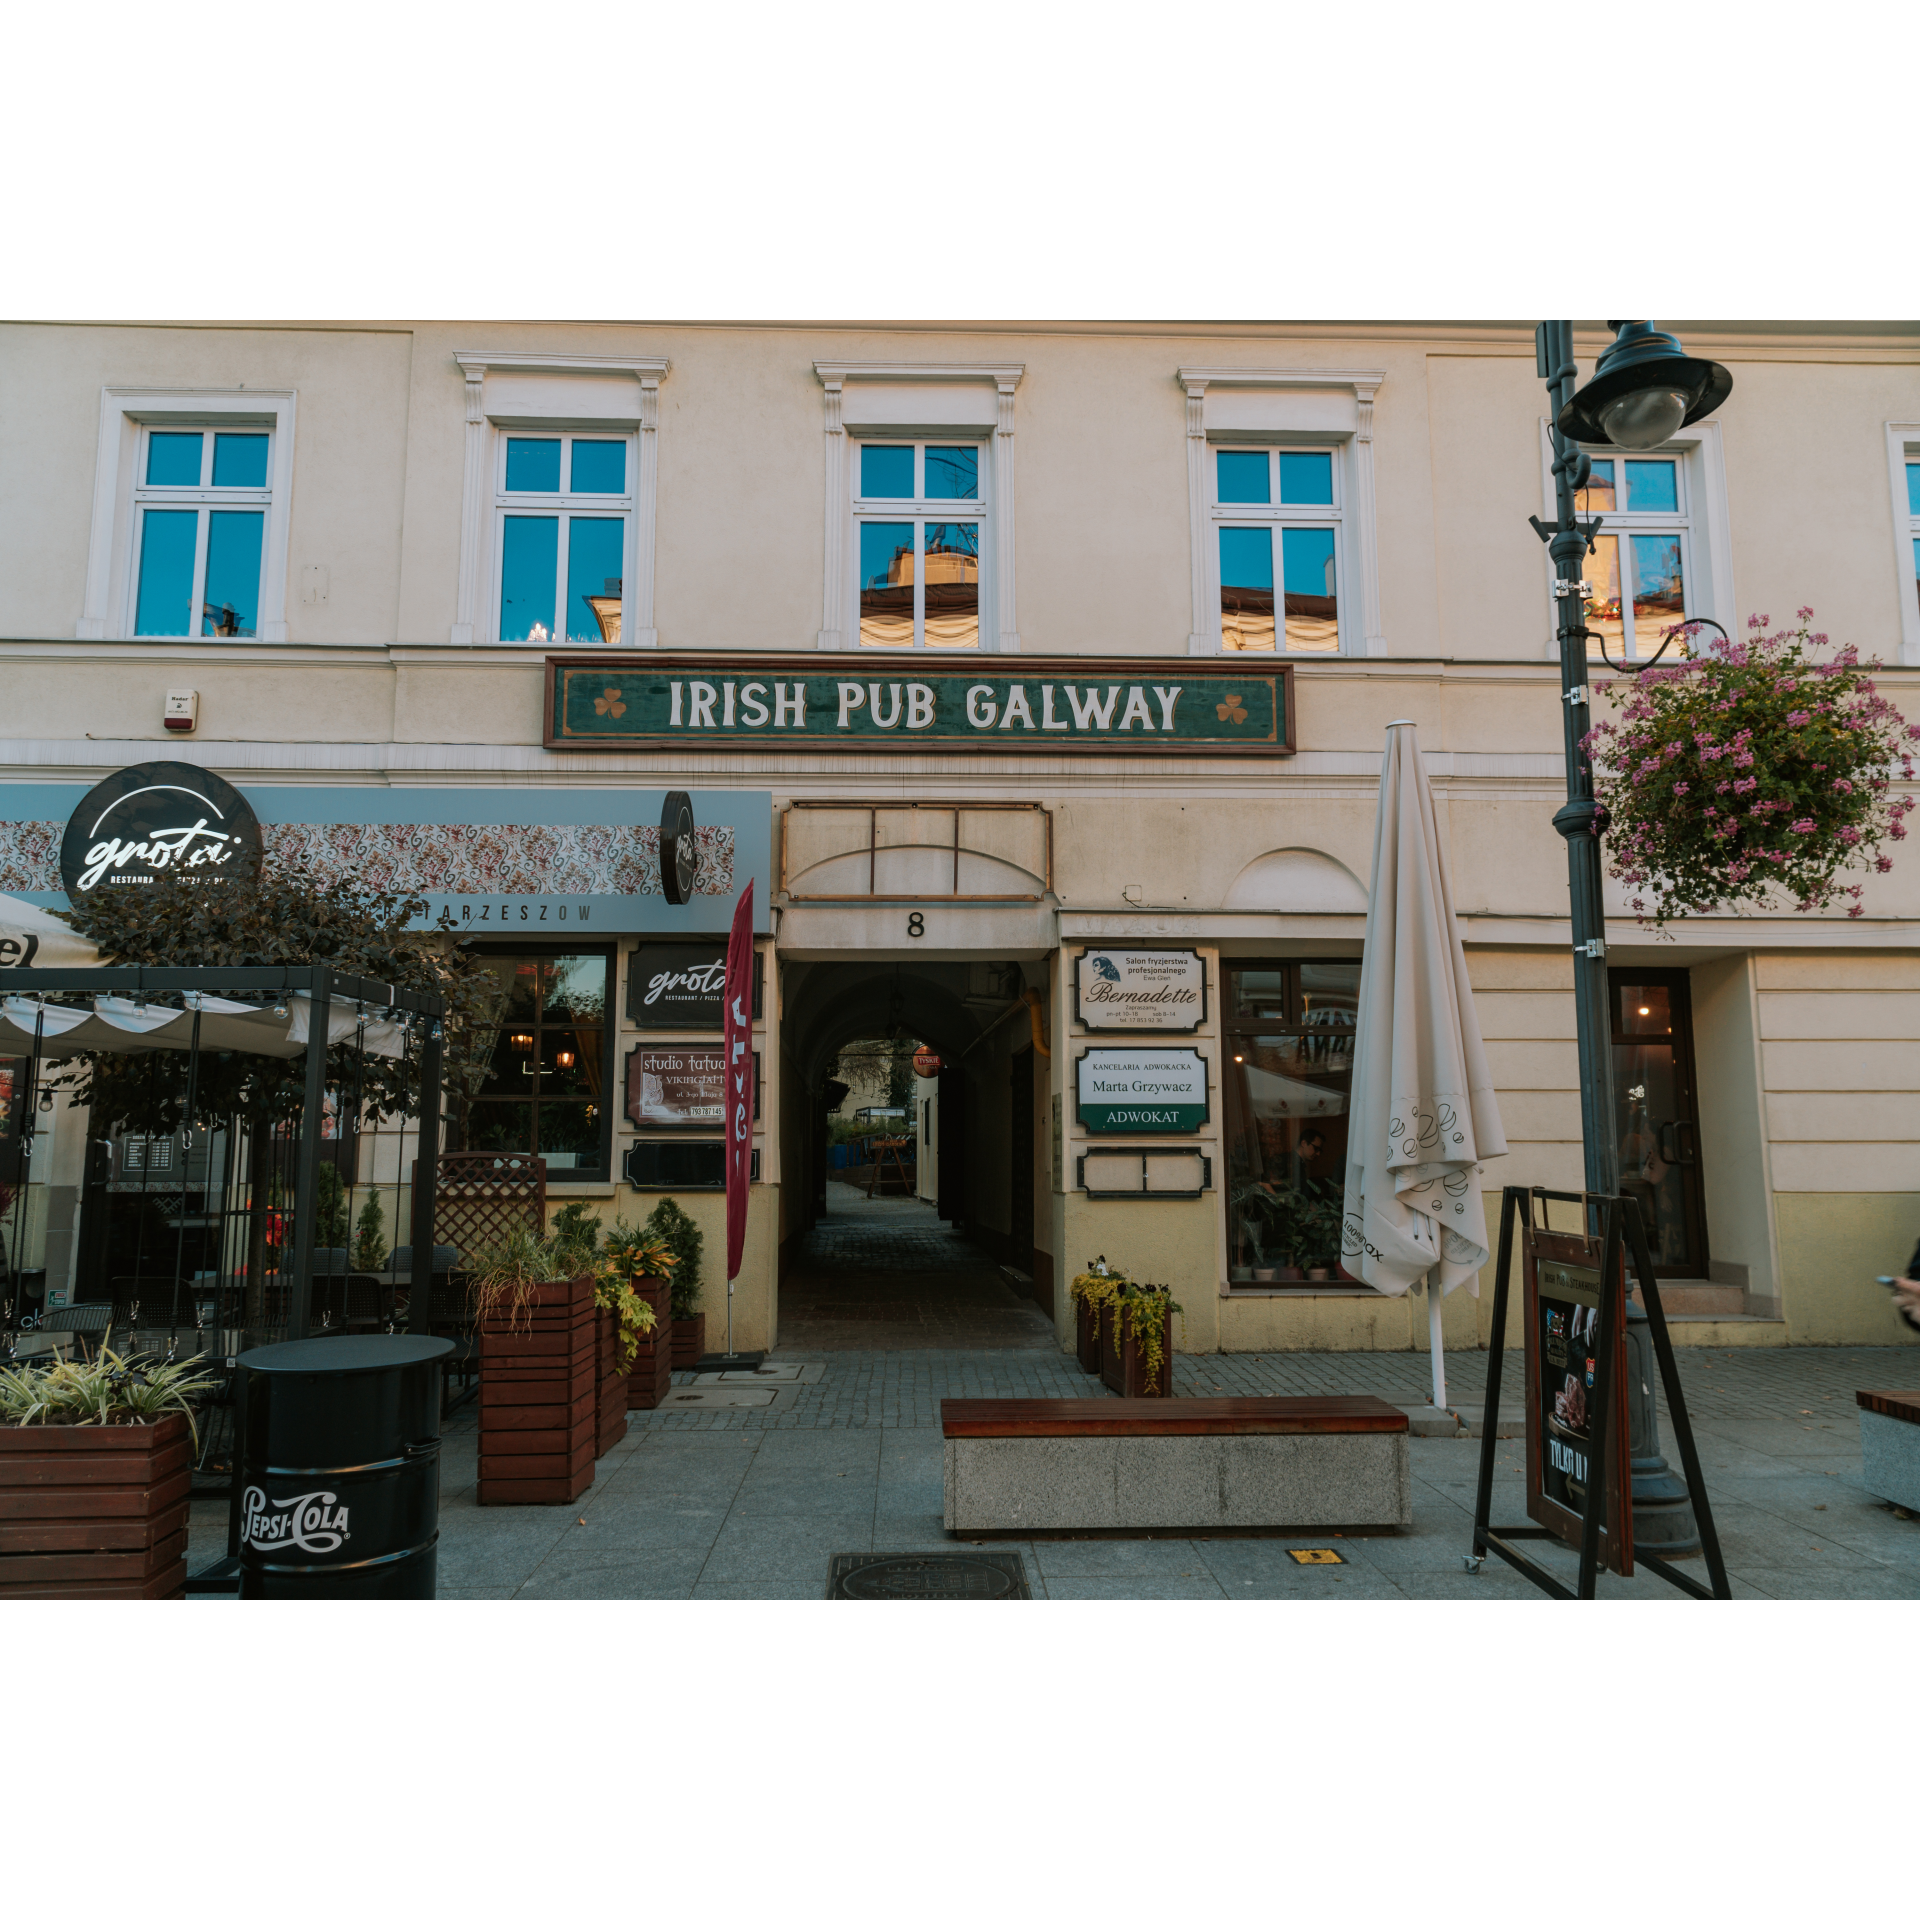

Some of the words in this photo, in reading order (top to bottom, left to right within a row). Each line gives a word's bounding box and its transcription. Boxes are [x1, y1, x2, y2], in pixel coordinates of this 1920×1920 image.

[669, 681, 807, 728] IRISH
[836, 682, 936, 730] PUB
[966, 684, 1183, 732] GALWAY
[76, 818, 233, 891] grota
[110, 875, 154, 884] RESTAURA
[364, 904, 591, 921] RTARZESZOW
[907, 912, 925, 937] 8
[0, 934, 39, 968] el
[1125, 957, 1146, 965] Salon
[1148, 957, 1188, 967] fryzjerstwa
[1128, 966, 1186, 975] profesjonalnego
[1085, 982, 1197, 1004] Bernadette
[644, 1055, 683, 1072] studio
[688, 1055, 726, 1072] tatua
[1092, 1080, 1128, 1092] Marta
[1132, 1080, 1193, 1095] Grzywacz
[712, 1107, 722, 1115] 145
[1106, 1111, 1180, 1123] ADWOKAT
